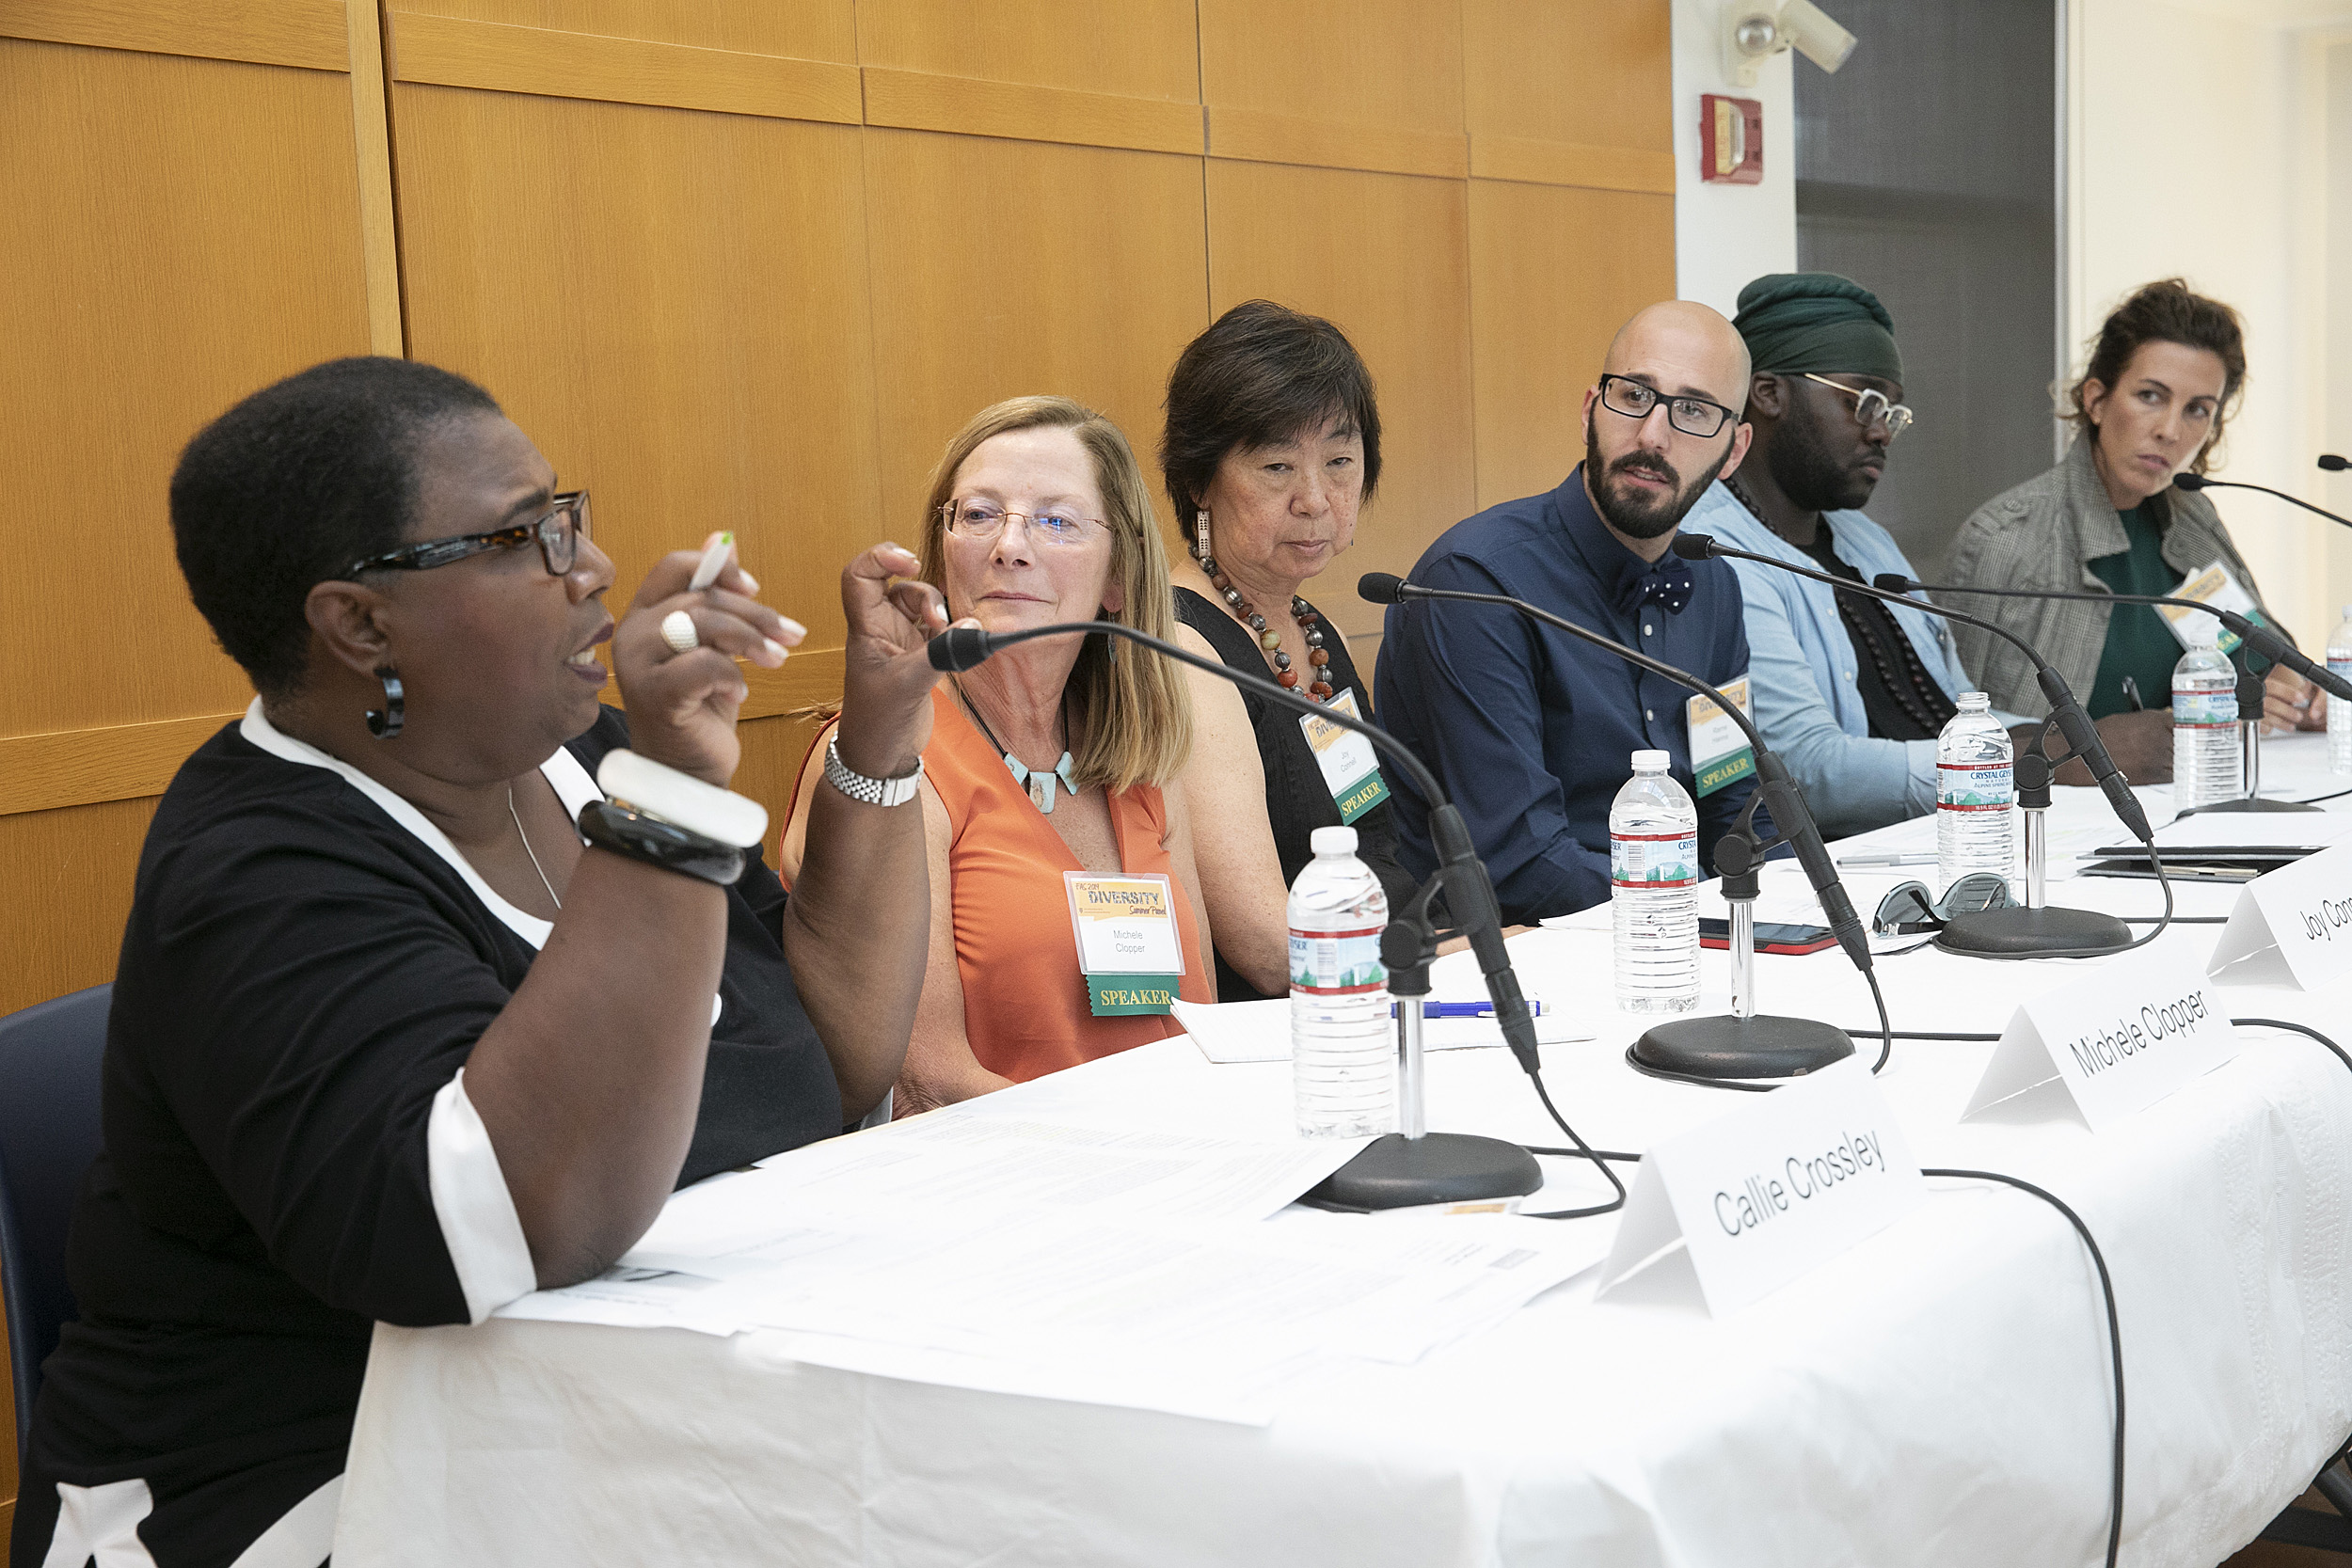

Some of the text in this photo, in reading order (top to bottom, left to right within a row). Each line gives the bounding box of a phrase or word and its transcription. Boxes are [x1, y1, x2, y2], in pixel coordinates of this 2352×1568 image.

[1702, 757, 1749, 788] SPEAKER
[1970, 771, 1998, 780] CRYSTAL
[1341, 782, 1381, 816] SPEAKER
[1088, 891, 1159, 905] DIVERSITY
[1113, 929, 1143, 940] Michele
[2300, 911, 2331, 942] Joy
[1116, 943, 1145, 954] Clopper
[1101, 990, 1171, 1006] SPEAKER
[2068, 989, 2209, 1078] Michele Clopper
[1713, 1129, 1885, 1237] Callie Crossley
